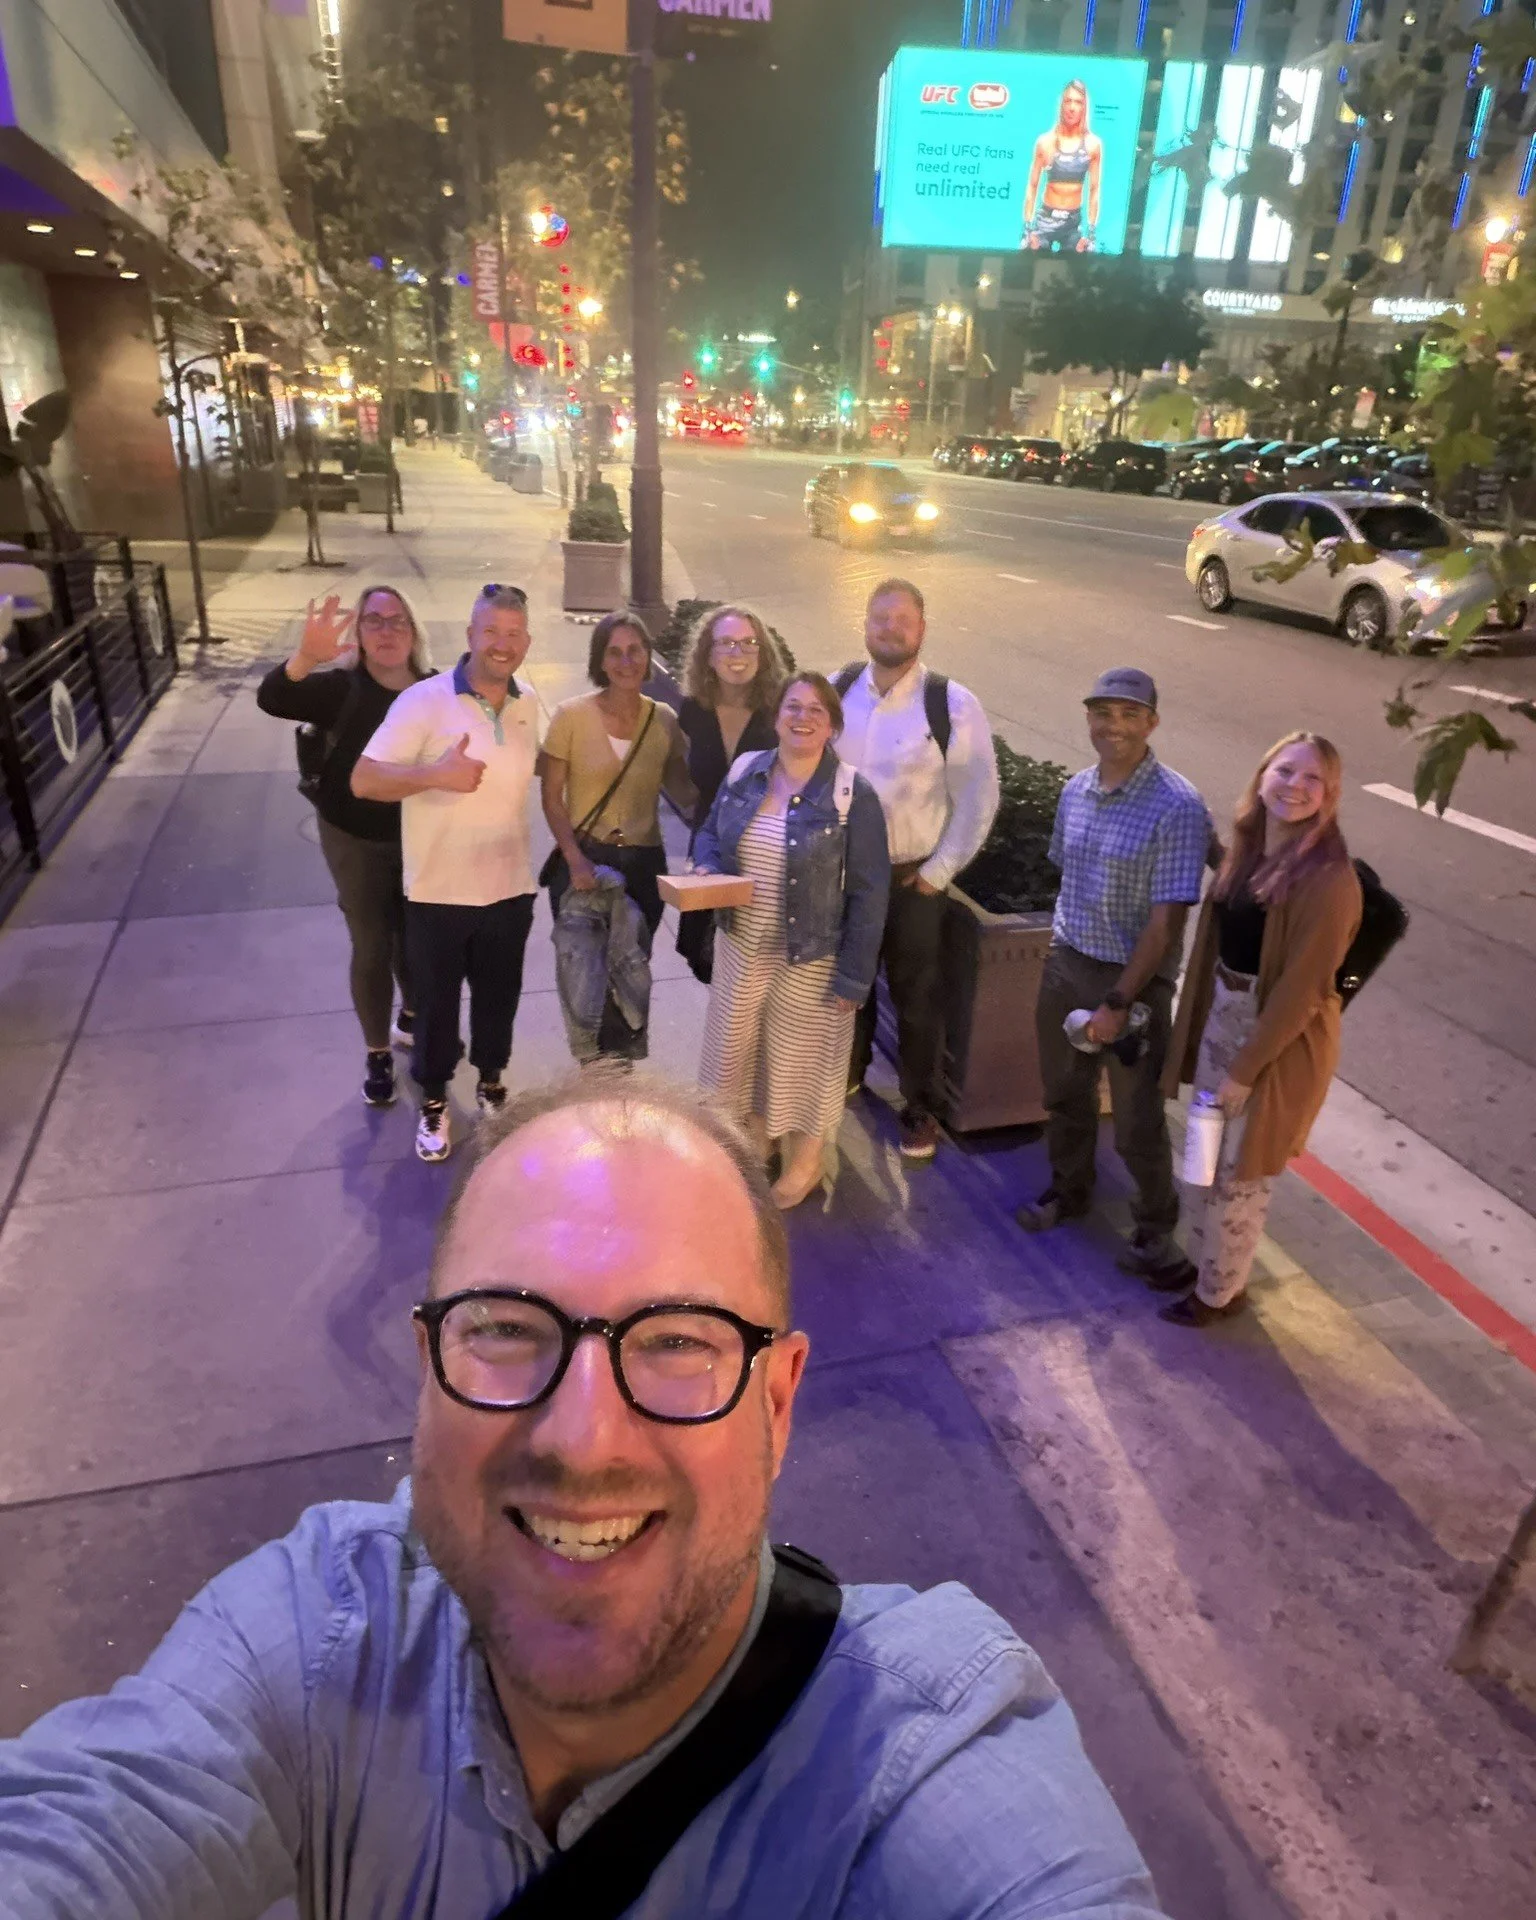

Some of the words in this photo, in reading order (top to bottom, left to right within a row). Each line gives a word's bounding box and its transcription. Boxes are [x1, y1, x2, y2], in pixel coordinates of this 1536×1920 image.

[921, 85, 960, 104] UFC
[917, 142, 948, 157] Real
[951, 144, 982, 158] UFC
[984, 145, 1015, 160] fans
[915, 161, 950, 174] need
[953, 162, 981, 175] real
[915, 178, 1011, 200] unlimited
[1202, 289, 1283, 312] COURTYARD
